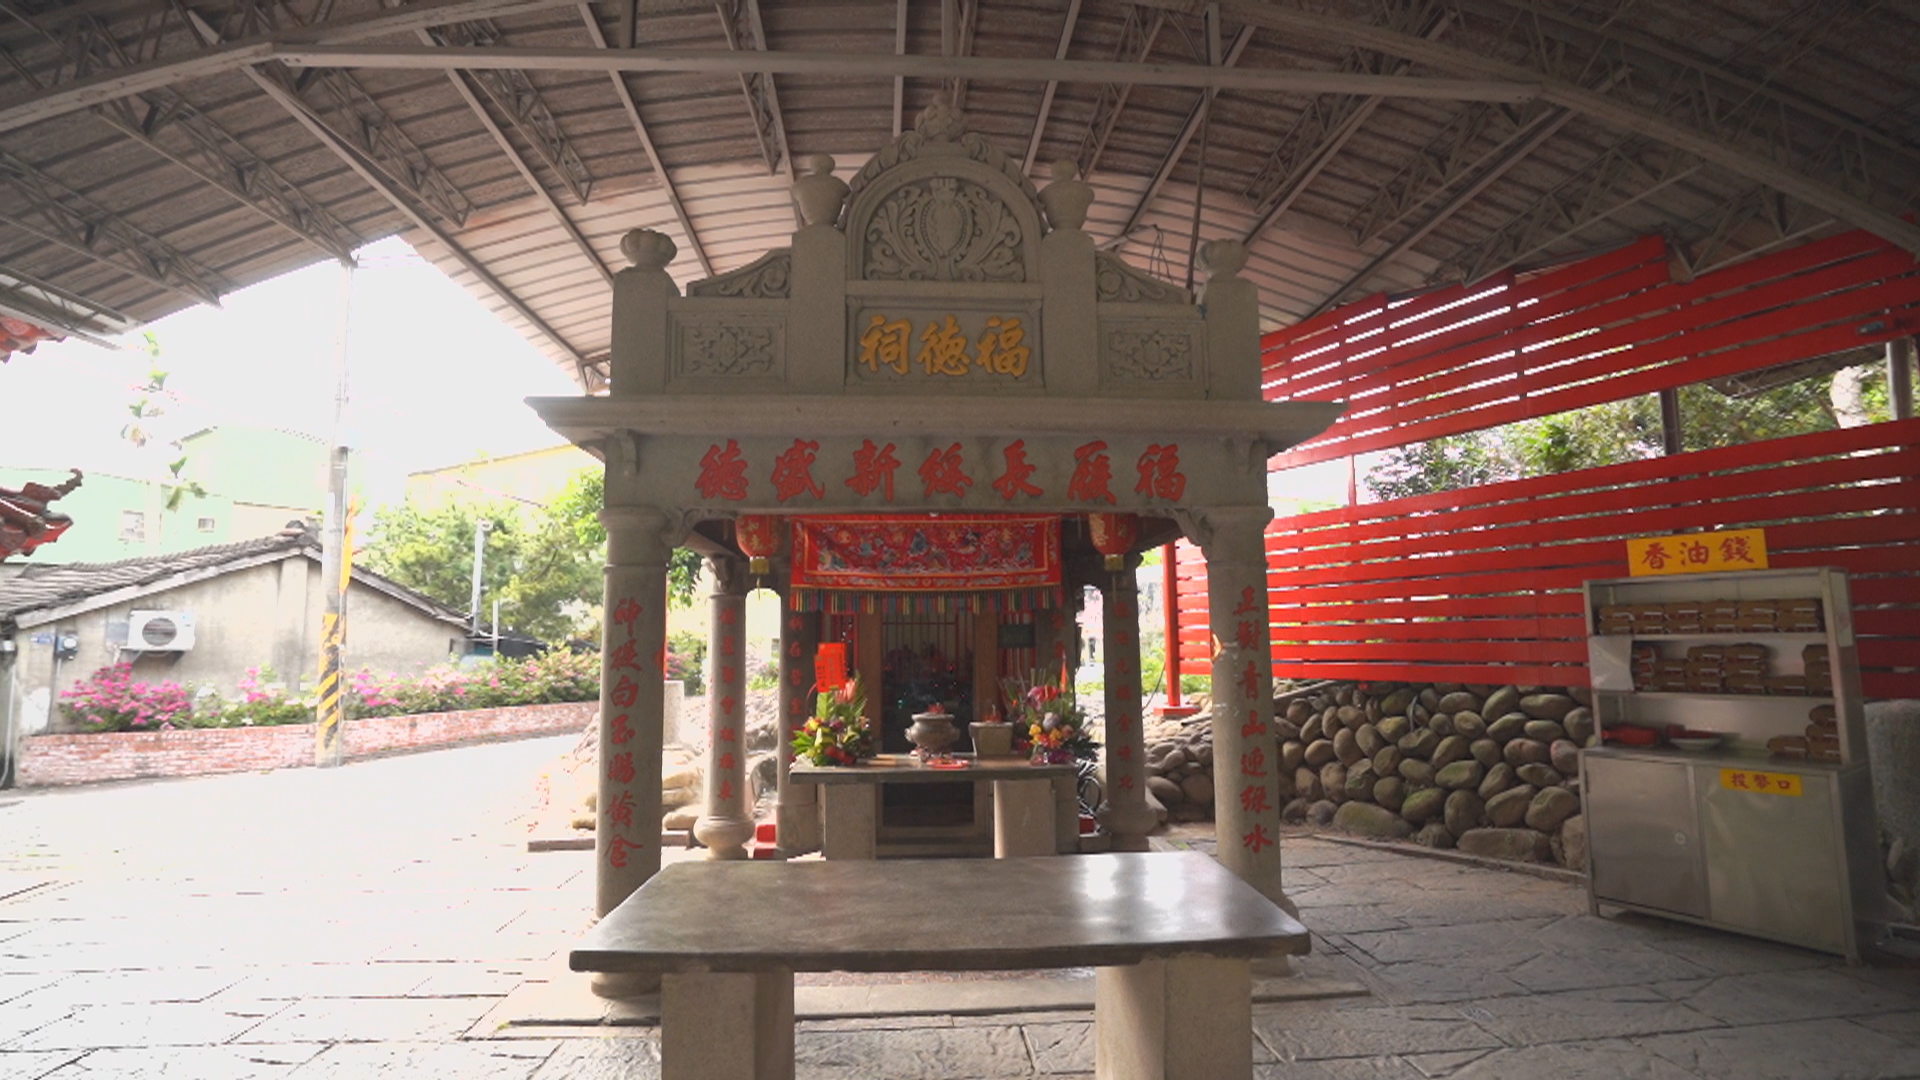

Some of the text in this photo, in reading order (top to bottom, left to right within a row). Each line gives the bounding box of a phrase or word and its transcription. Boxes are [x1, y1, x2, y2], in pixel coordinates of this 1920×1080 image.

[1642, 536, 1755, 570] 香油錢
[1731, 772, 1790, 791] 投幣口
